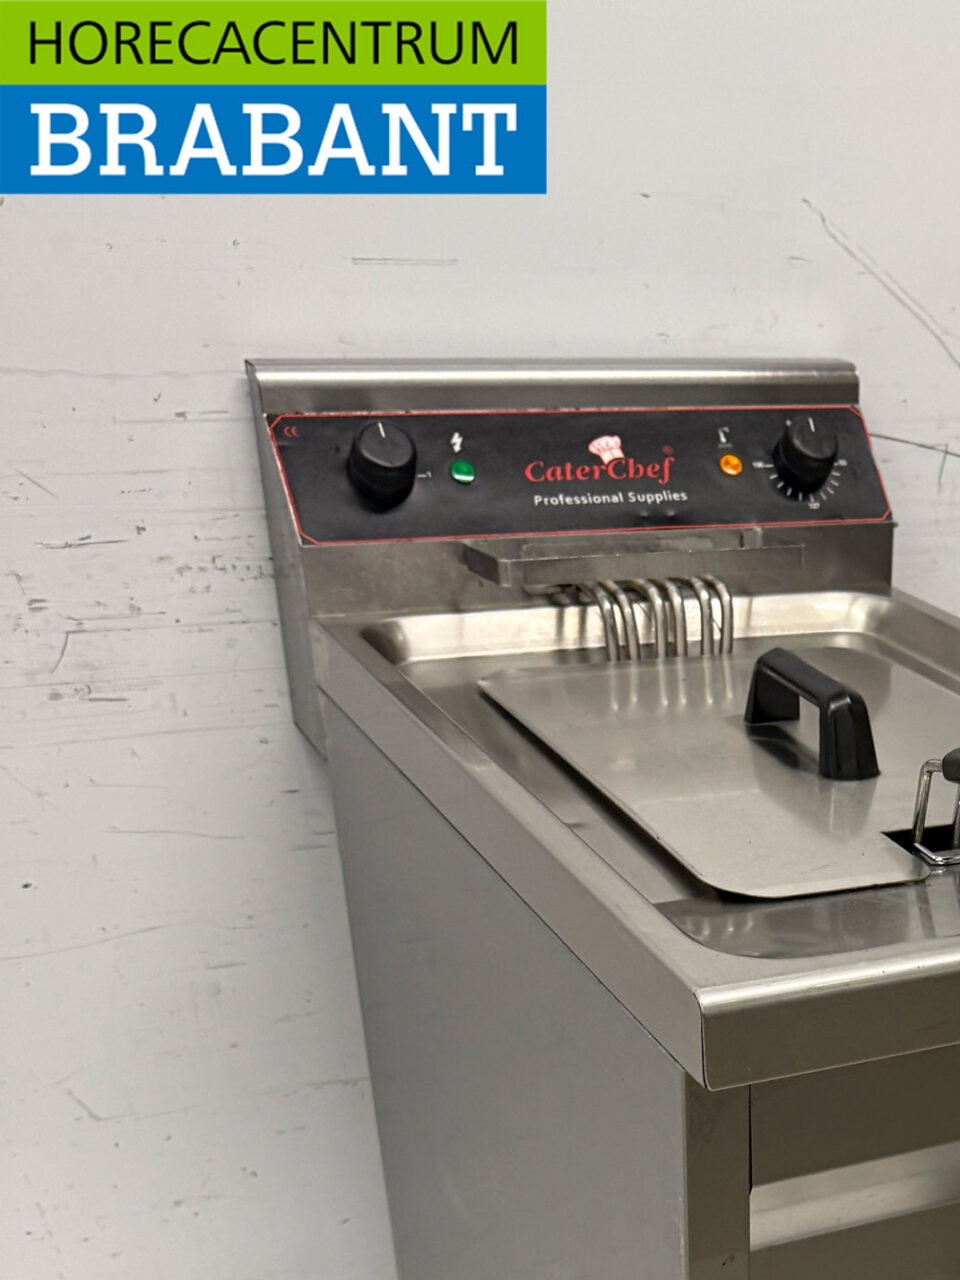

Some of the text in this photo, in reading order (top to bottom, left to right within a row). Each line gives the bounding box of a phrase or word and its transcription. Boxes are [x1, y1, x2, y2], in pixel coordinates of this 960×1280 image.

[525, 457, 674, 484] CaterChef
[534, 490, 688, 506] Professional Supplies
